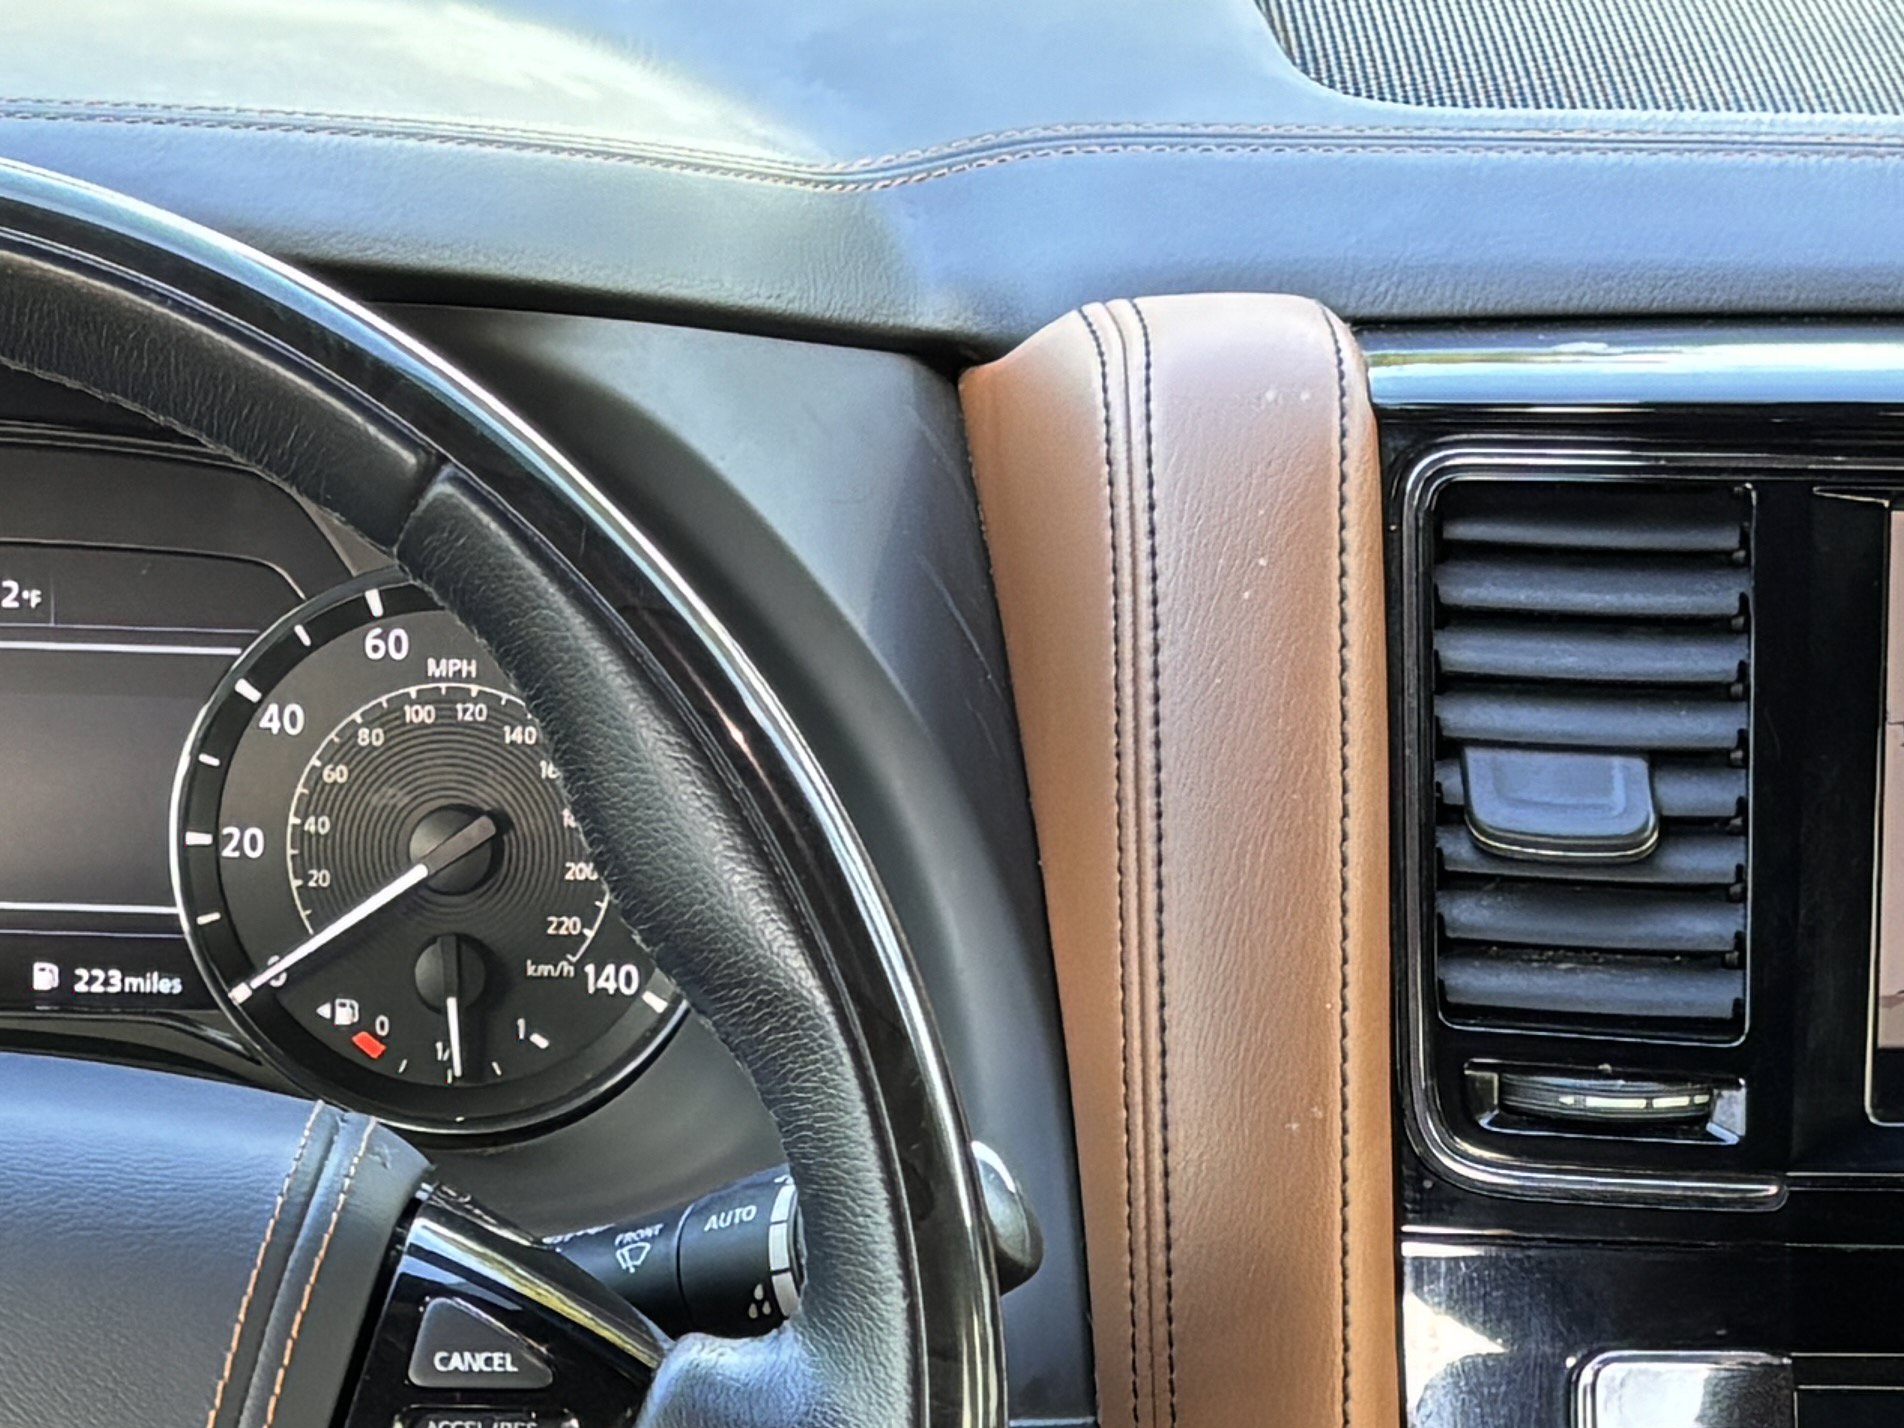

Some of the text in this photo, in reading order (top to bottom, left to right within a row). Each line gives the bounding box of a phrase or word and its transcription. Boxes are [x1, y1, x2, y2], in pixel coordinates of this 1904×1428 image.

[364, 628, 410, 660] 60
[427, 659, 477, 678] MPH
[259, 703, 305, 736] 40
[403, 704, 437, 724] 100
[456, 703, 488, 723] 120
[357, 727, 385, 747] 80
[503, 725, 537, 746] 140
[322, 764, 349, 784] 60
[303, 815, 331, 835] 40
[221, 828, 265, 859] 20
[307, 868, 331, 888] 20
[546, 916, 583, 935] 220
[526, 959, 576, 981] km/h
[584, 963, 640, 996] 140
[374, 1014, 390, 1037] 0
[516, 1019, 526, 1040] 1
[703, 1204, 758, 1233] AUTO
[433, 1351, 519, 1374] CANCEL
